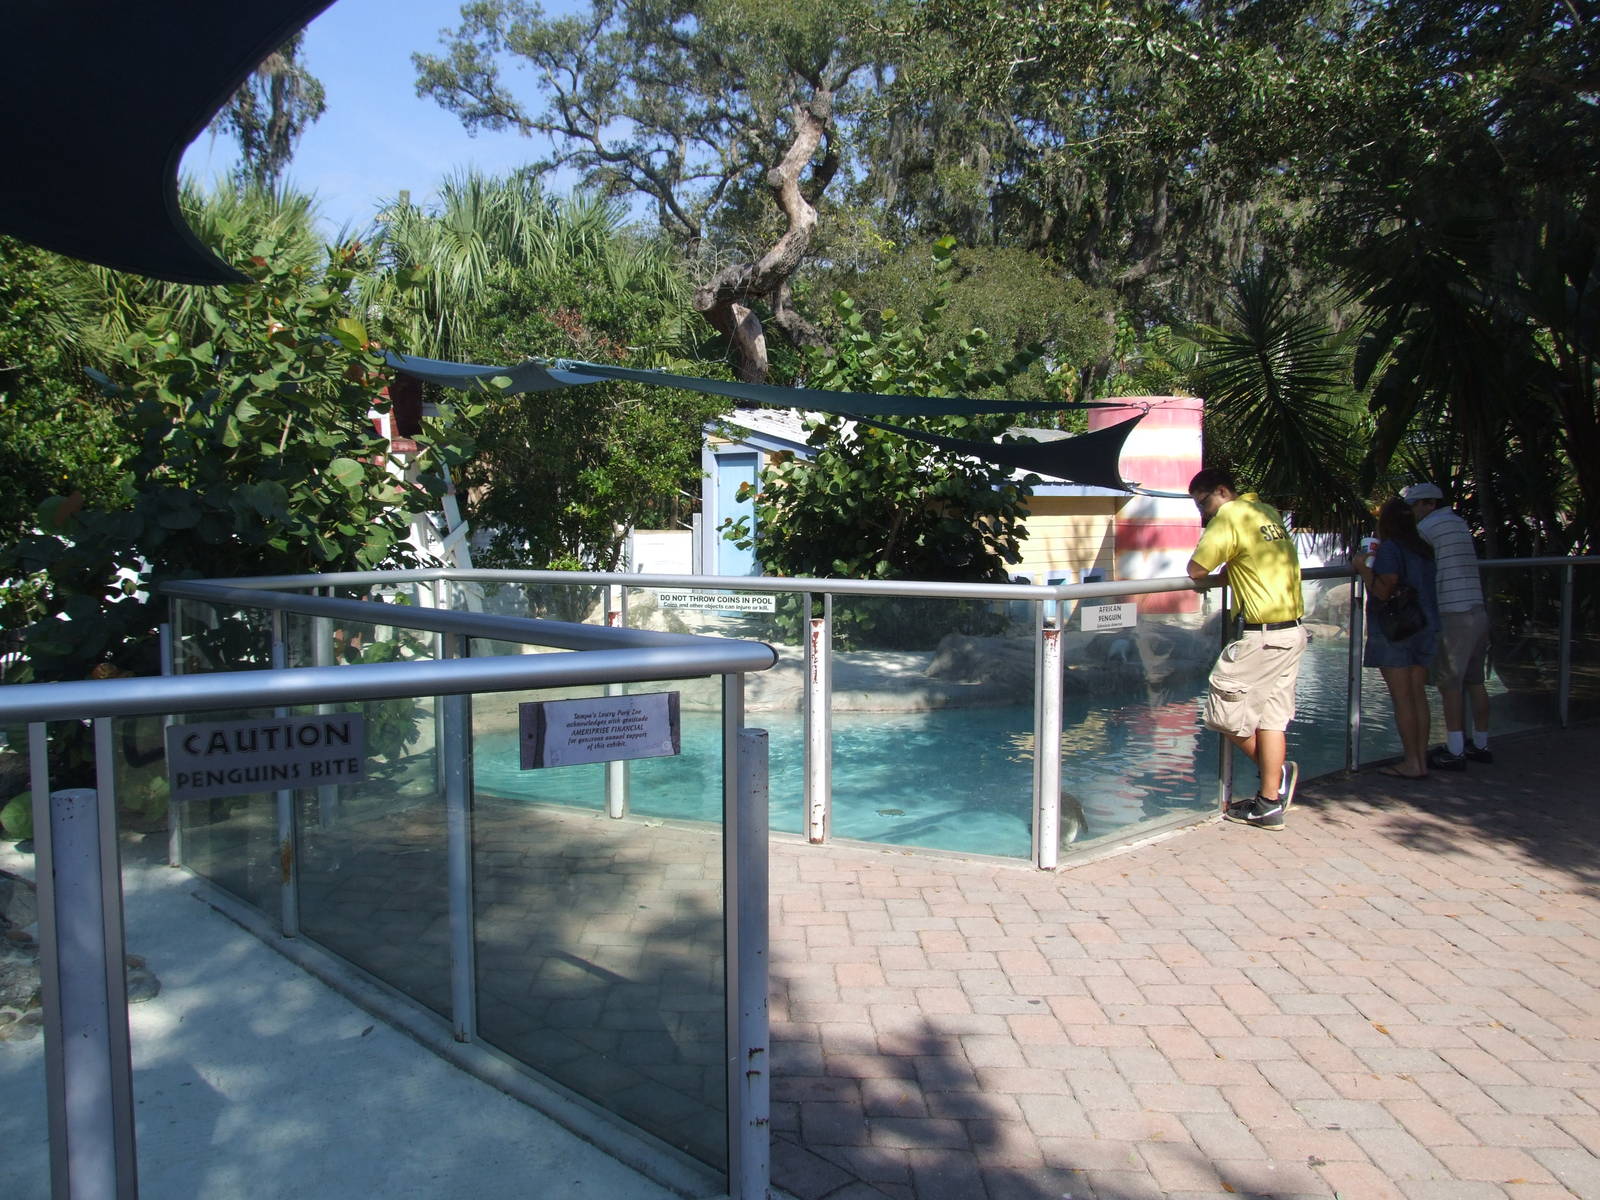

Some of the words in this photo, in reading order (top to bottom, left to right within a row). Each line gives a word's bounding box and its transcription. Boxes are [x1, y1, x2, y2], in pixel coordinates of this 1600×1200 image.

[672, 594, 687, 602] NOT
[689, 595, 716, 603] THROW
[751, 597, 773, 605] POOL
[1098, 604, 1122, 613] AFRICAN
[1098, 614, 1122, 622] PENGUIN
[574, 711, 597, 720] Tampa's
[598, 710, 615, 719] Lowry
[617, 708, 630, 717] Park
[566, 718, 607, 728] acknowledges
[622, 714, 648, 725] gratitude
[571, 727, 609, 736] AMERIPRISE
[610, 724, 644, 733] FINANCIAL
[184, 721, 350, 755] CAUTION
[568, 737, 577, 746] for
[578, 735, 604, 744] generous
[605, 732, 625, 741] annual
[626, 732, 648, 740] support
[587, 743, 594, 751] of
[176, 763, 302, 789] PENGUINS
[310, 757, 360, 777] BITE
